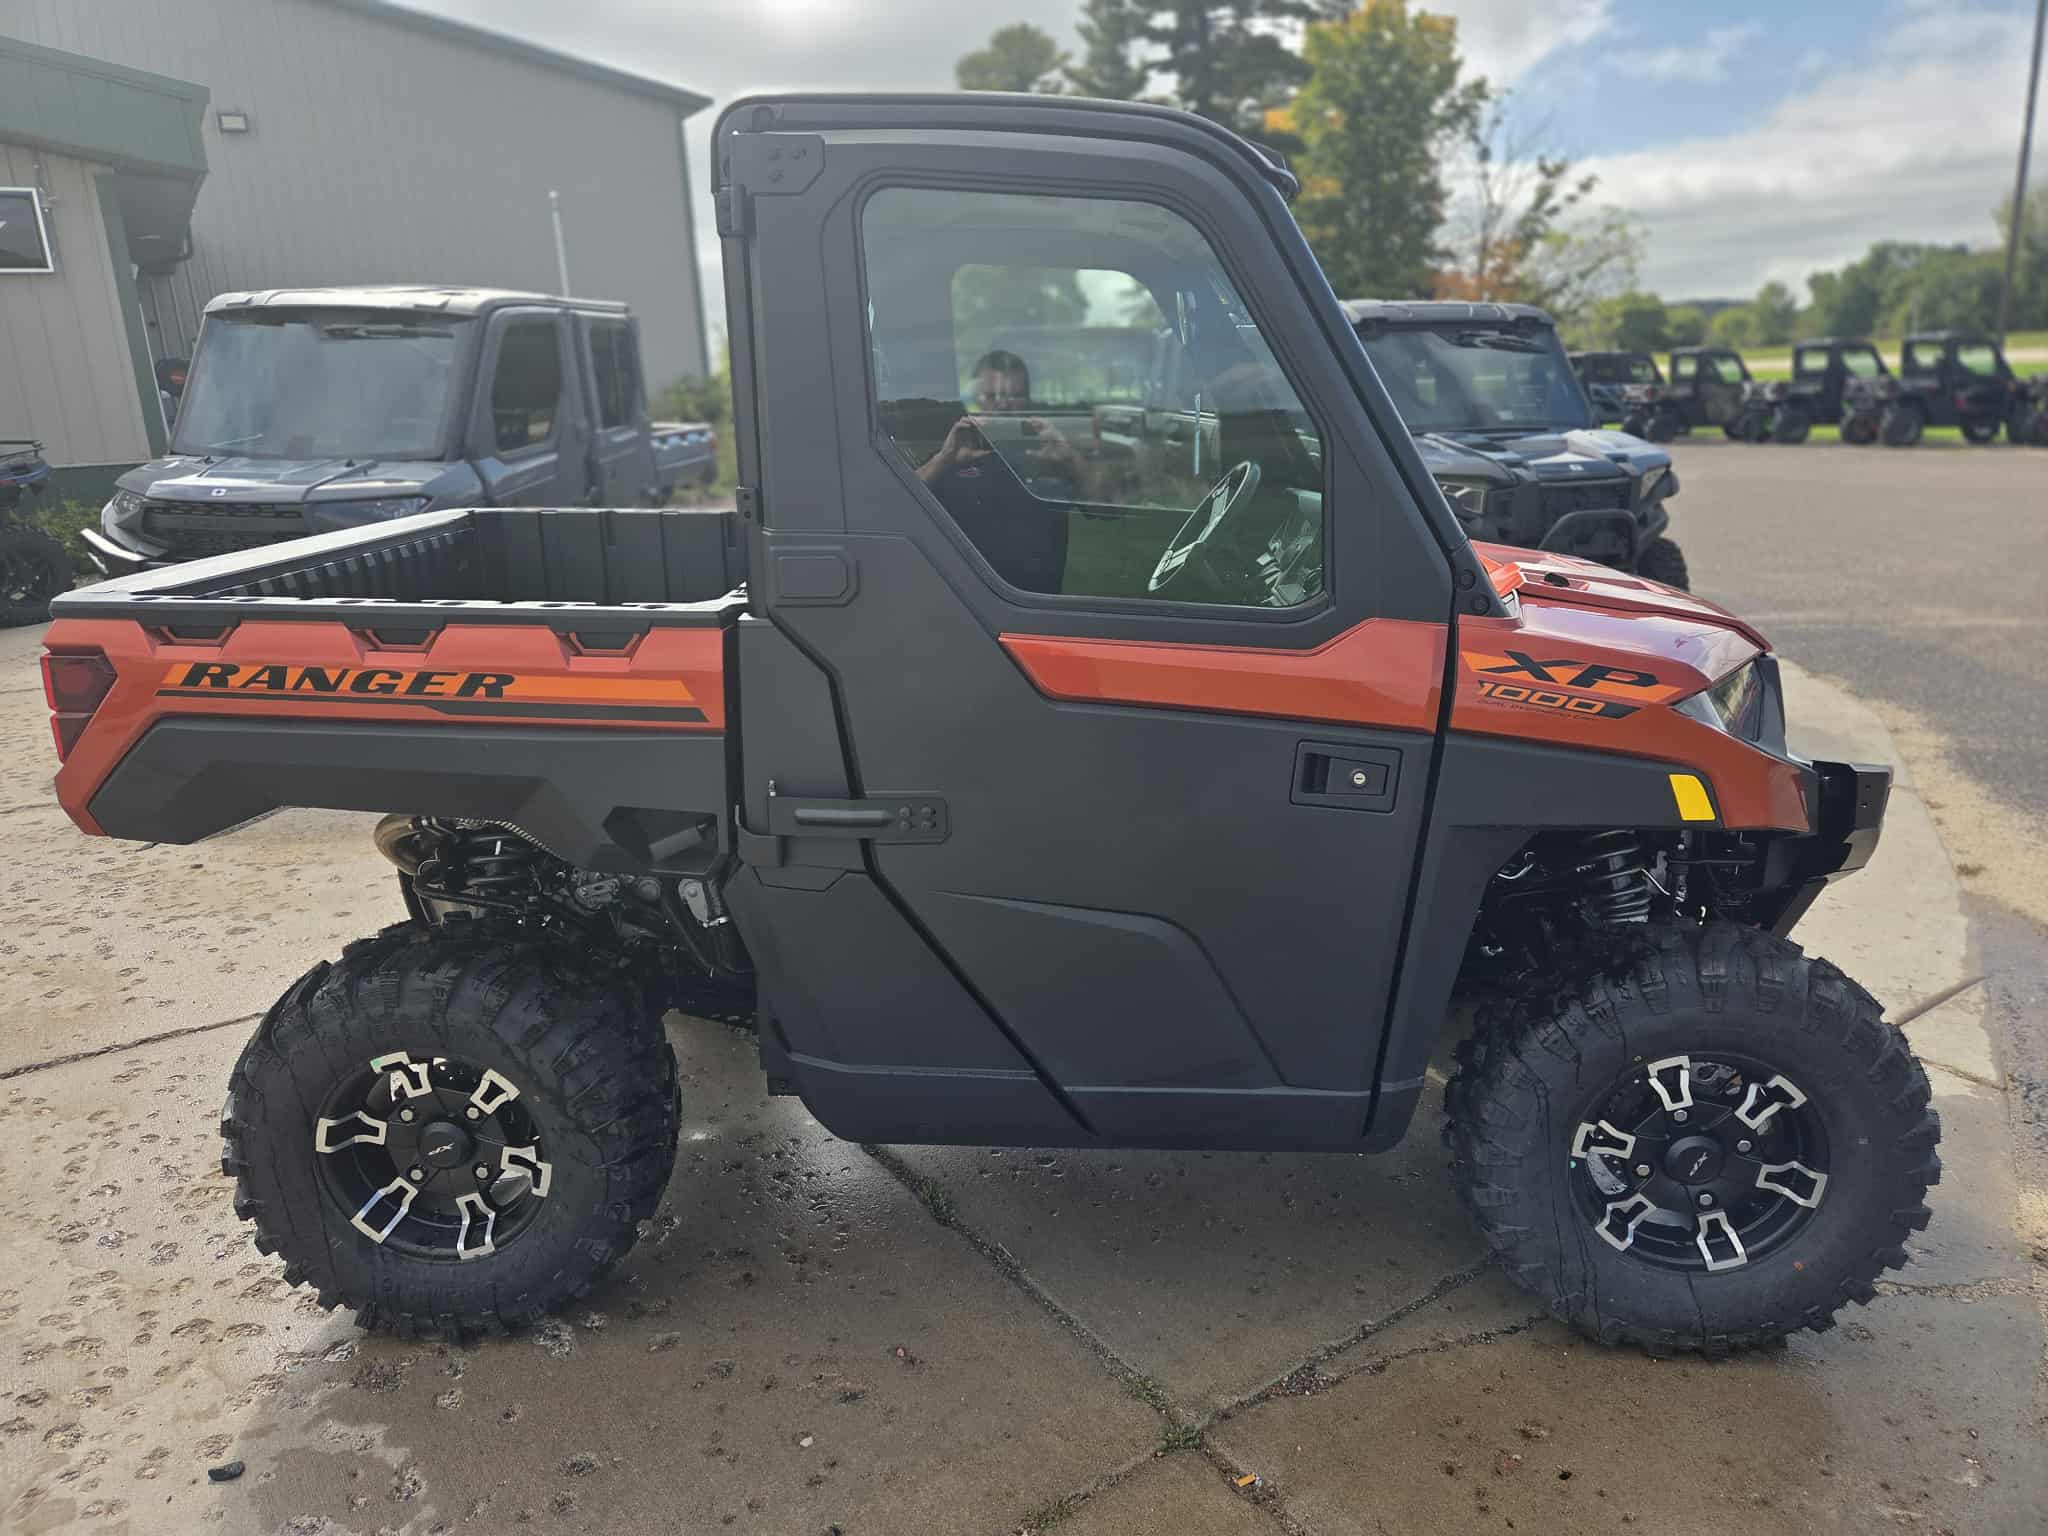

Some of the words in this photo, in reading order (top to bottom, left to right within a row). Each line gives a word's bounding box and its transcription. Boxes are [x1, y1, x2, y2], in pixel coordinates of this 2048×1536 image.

[180, 662, 515, 697] RANGER
[1476, 650, 1660, 688] XP
[1479, 682, 1606, 714] 1000
